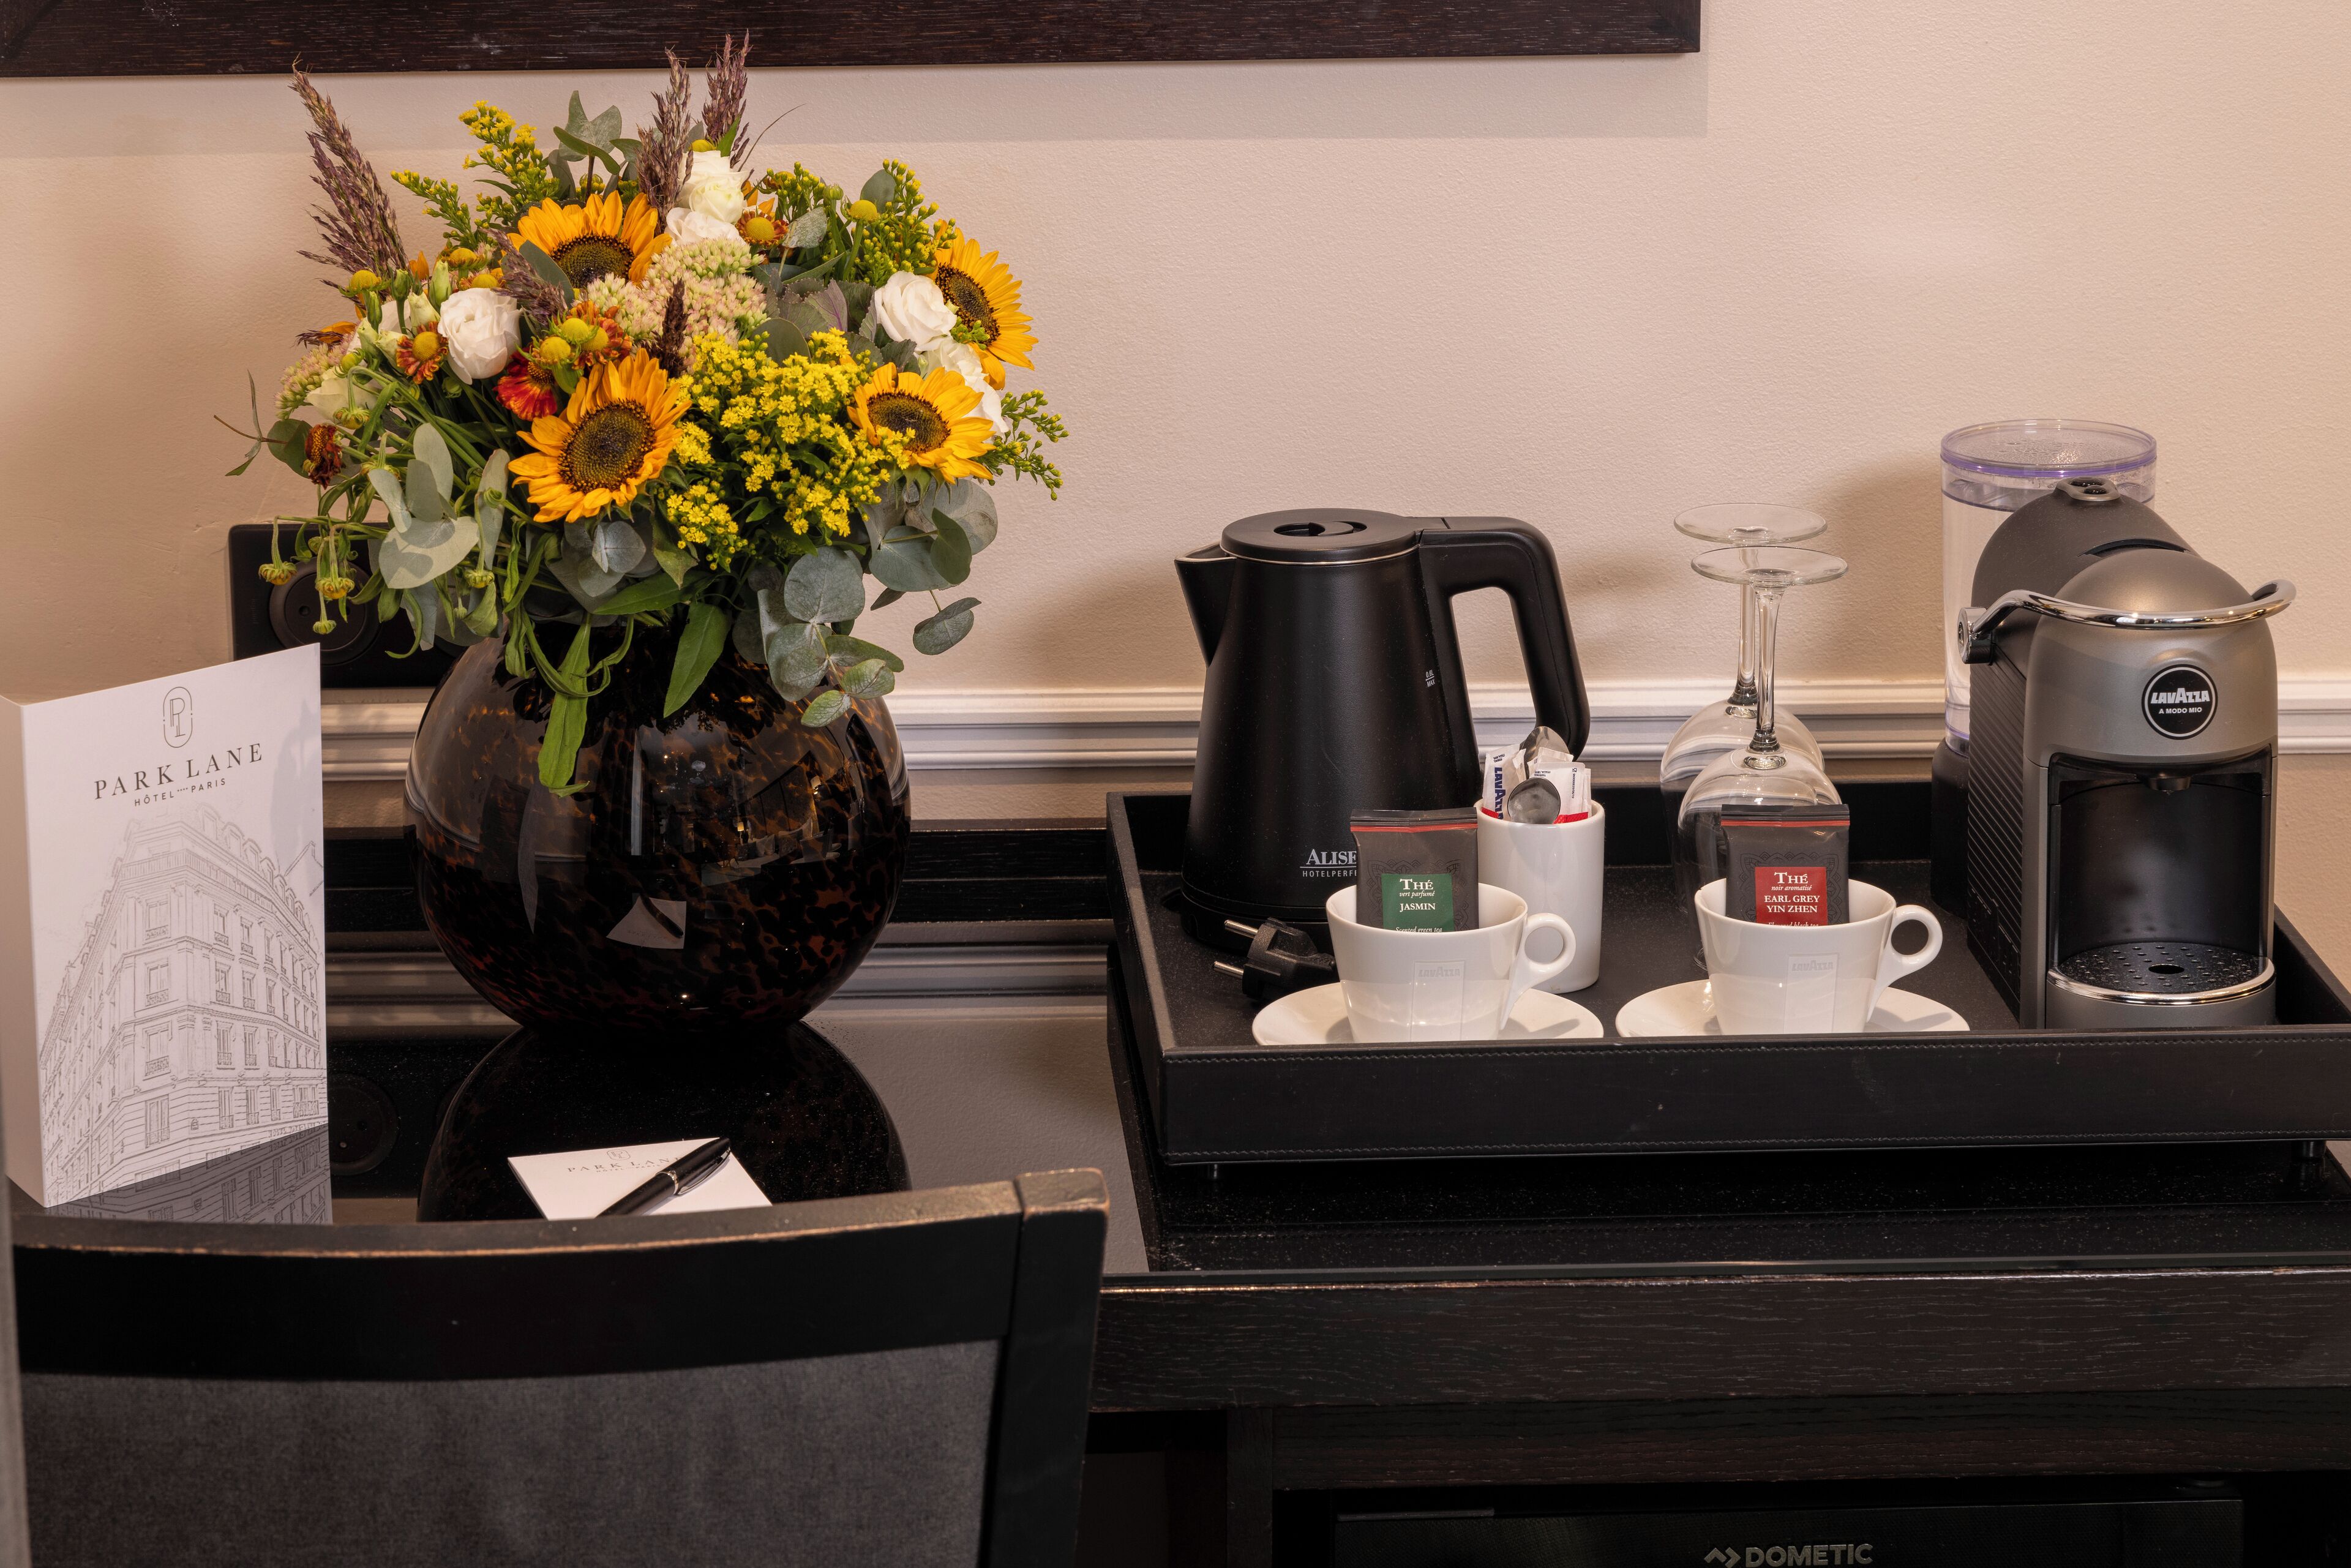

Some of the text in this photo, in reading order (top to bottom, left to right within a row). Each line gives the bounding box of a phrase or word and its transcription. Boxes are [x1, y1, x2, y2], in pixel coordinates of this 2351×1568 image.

[1427, 679, 1436, 688] MAX
[2150, 688, 2210, 704] LAVAZZA
[94, 743, 262, 800] PARK LANE
[135, 778, 226, 806] HÔTEL PARIS
[1400, 878, 1433, 890] THÉ
[1774, 872, 1809, 884] THÉ
[1411, 890, 1435, 899] parfumé
[1400, 902, 1436, 912] JASMIN
[1792, 960, 1834, 971] LAVAZZA
[1418, 966, 1460, 978] LAVAZZA
[568, 1162, 622, 1172] PARK
[1745, 1544, 1873, 1568] DOMETIC
